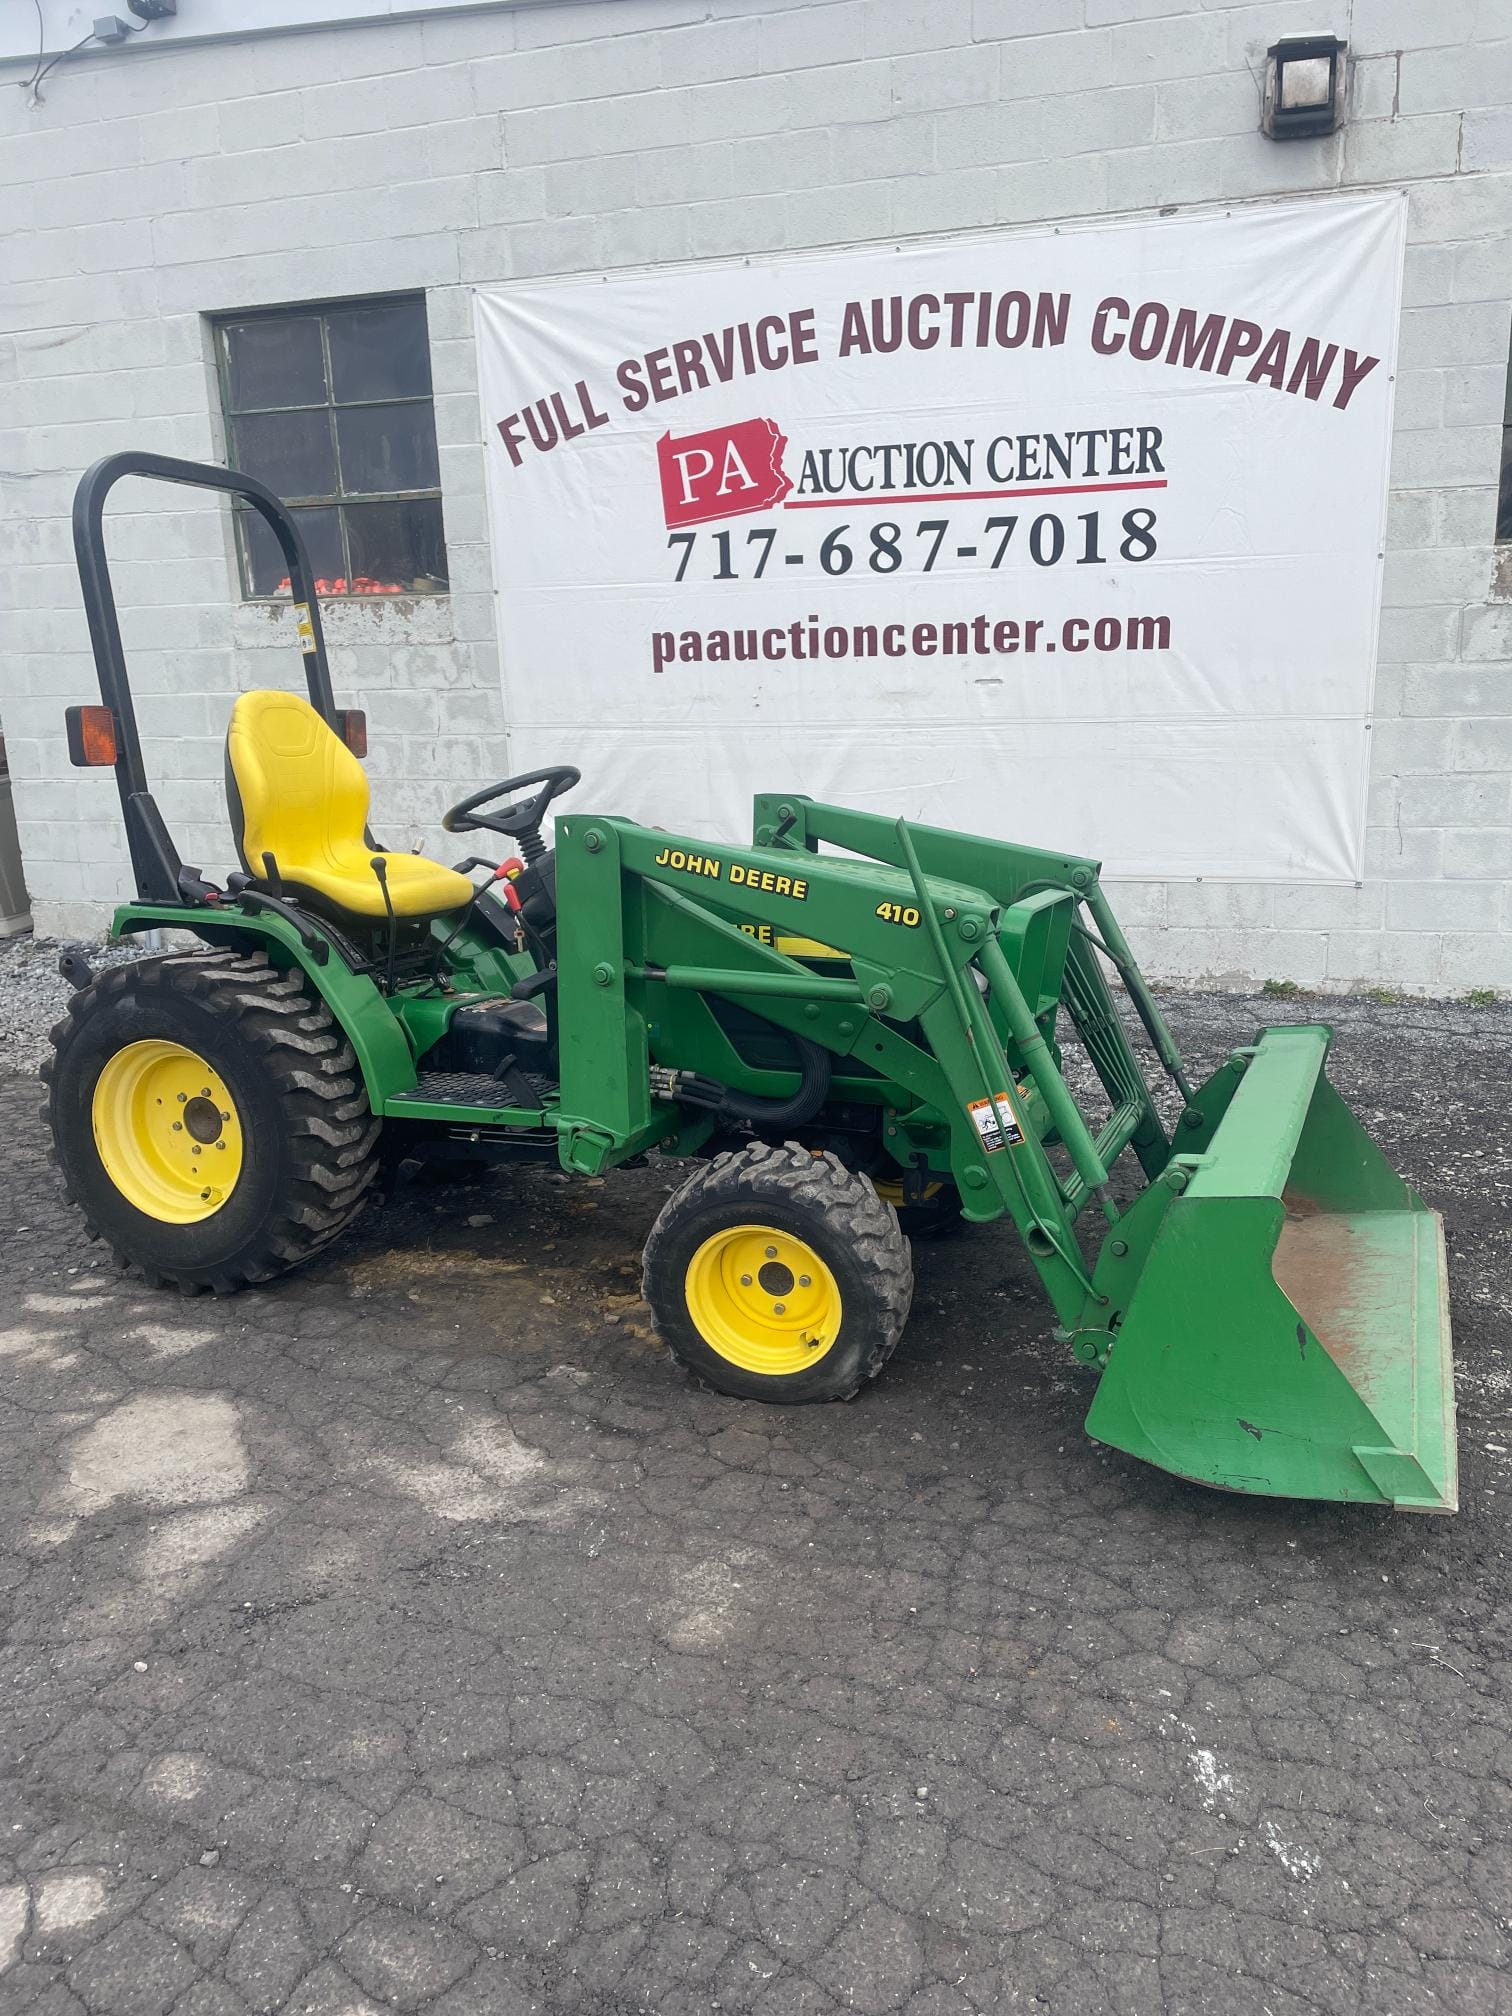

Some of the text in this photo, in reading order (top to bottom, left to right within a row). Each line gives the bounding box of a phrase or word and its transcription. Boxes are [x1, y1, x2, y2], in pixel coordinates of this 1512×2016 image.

[497, 291, 1380, 467] FULL SERVICE AUCTION COMPANY
[673, 426, 1165, 504] PA AUCTION CENTER
[666, 508, 1158, 582] 717-687-7018
[652, 614, 1171, 673] paauctioncenter.com
[655, 848, 807, 899] JOHN DEERE
[875, 901, 920, 927] 410
